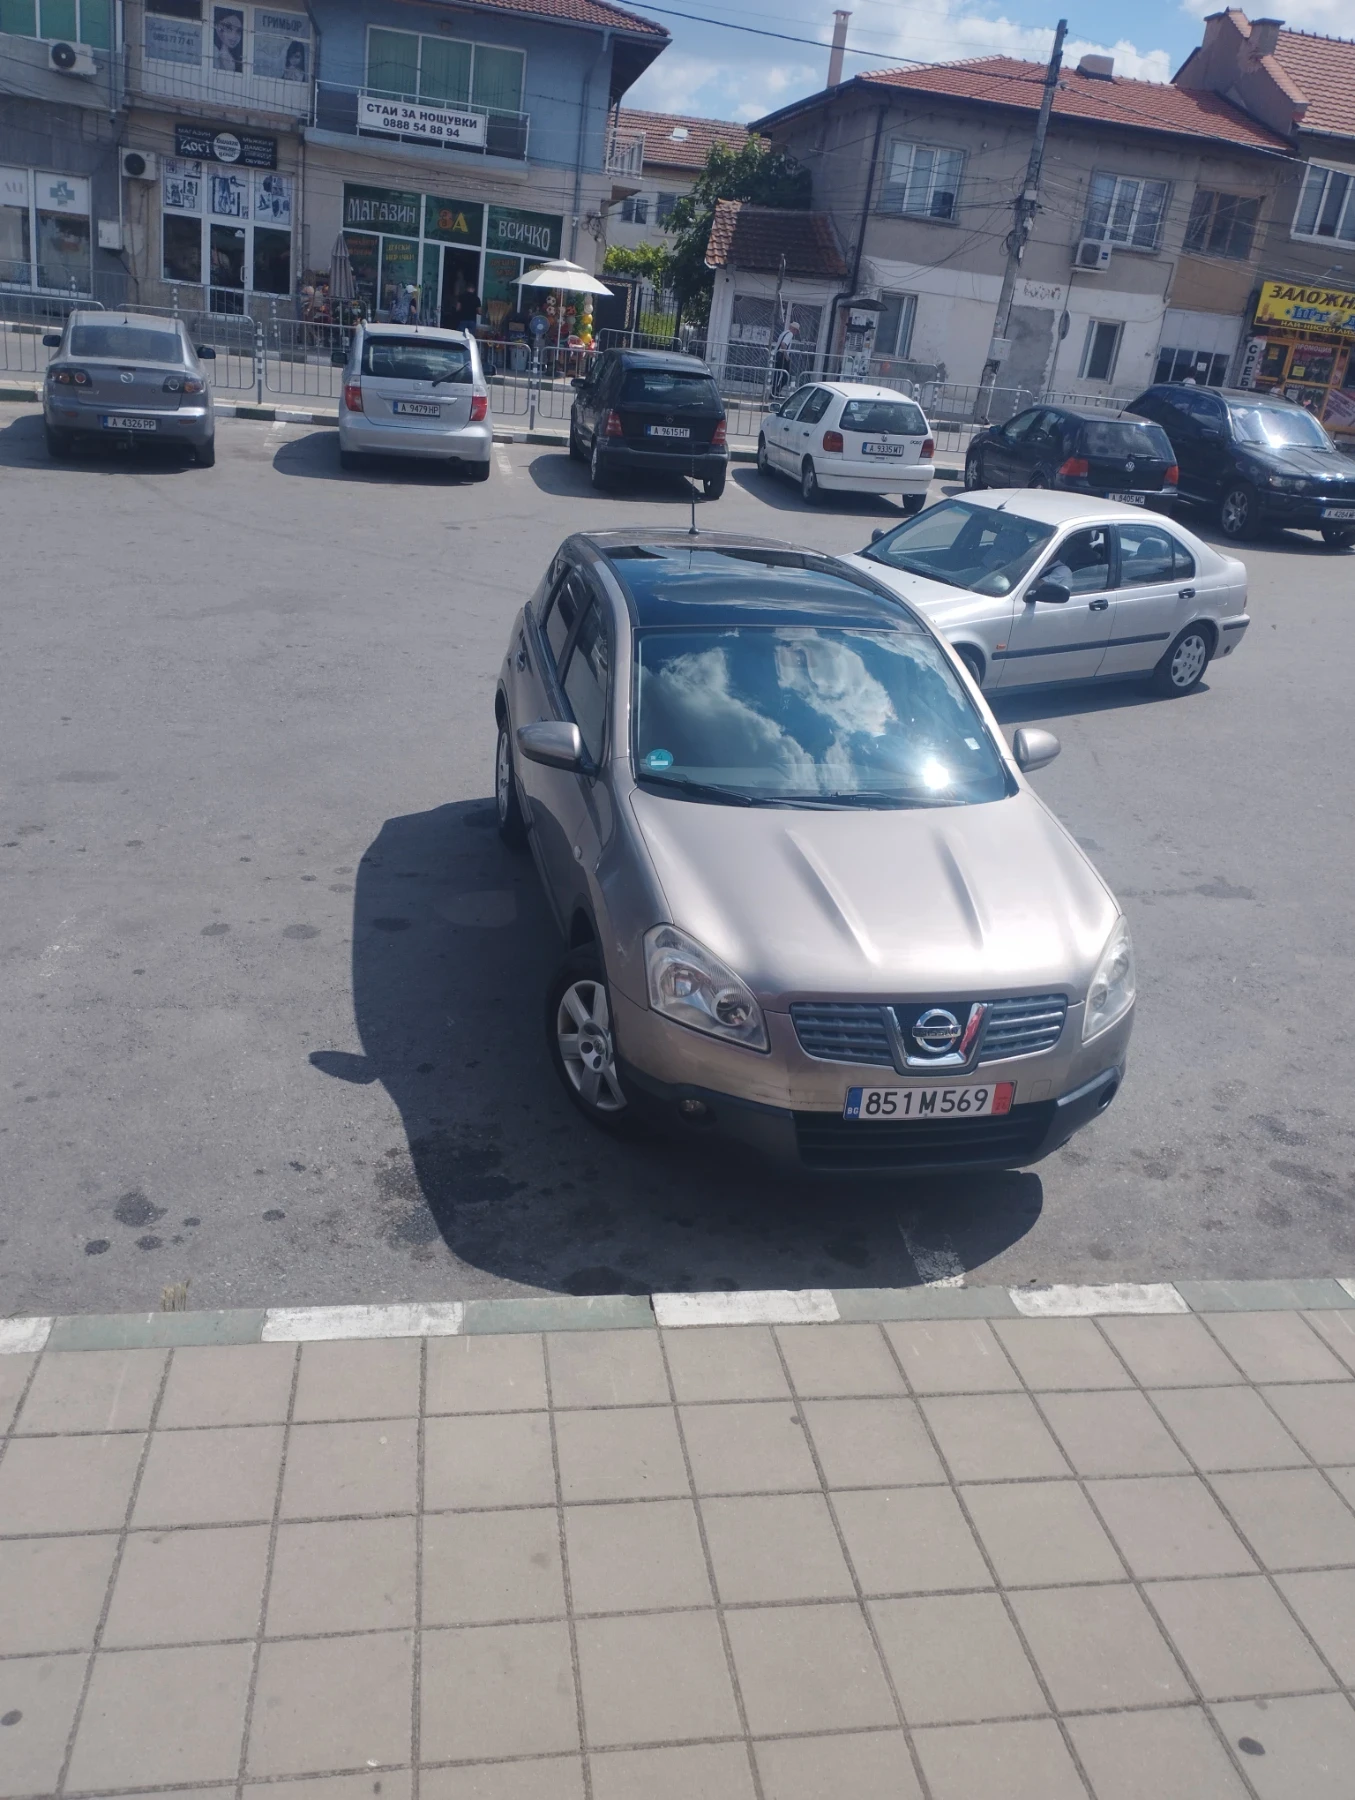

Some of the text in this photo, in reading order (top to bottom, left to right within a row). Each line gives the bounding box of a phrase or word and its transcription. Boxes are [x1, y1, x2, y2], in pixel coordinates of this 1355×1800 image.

[366, 103, 478, 128] СТАИ ЗА НОЩУВКИ
[178, 128, 211, 137] МАГАЗИН
[382, 118, 460, 137] 0888 54 88 94
[348, 198, 551, 252] МАГАЗИН ЗА ВСИЧКО
[1295, 343, 1332, 354] ПРОМОЦИЯ
[847, 1107, 859, 1115] BG
[865, 1088, 989, 1115] 851M569
